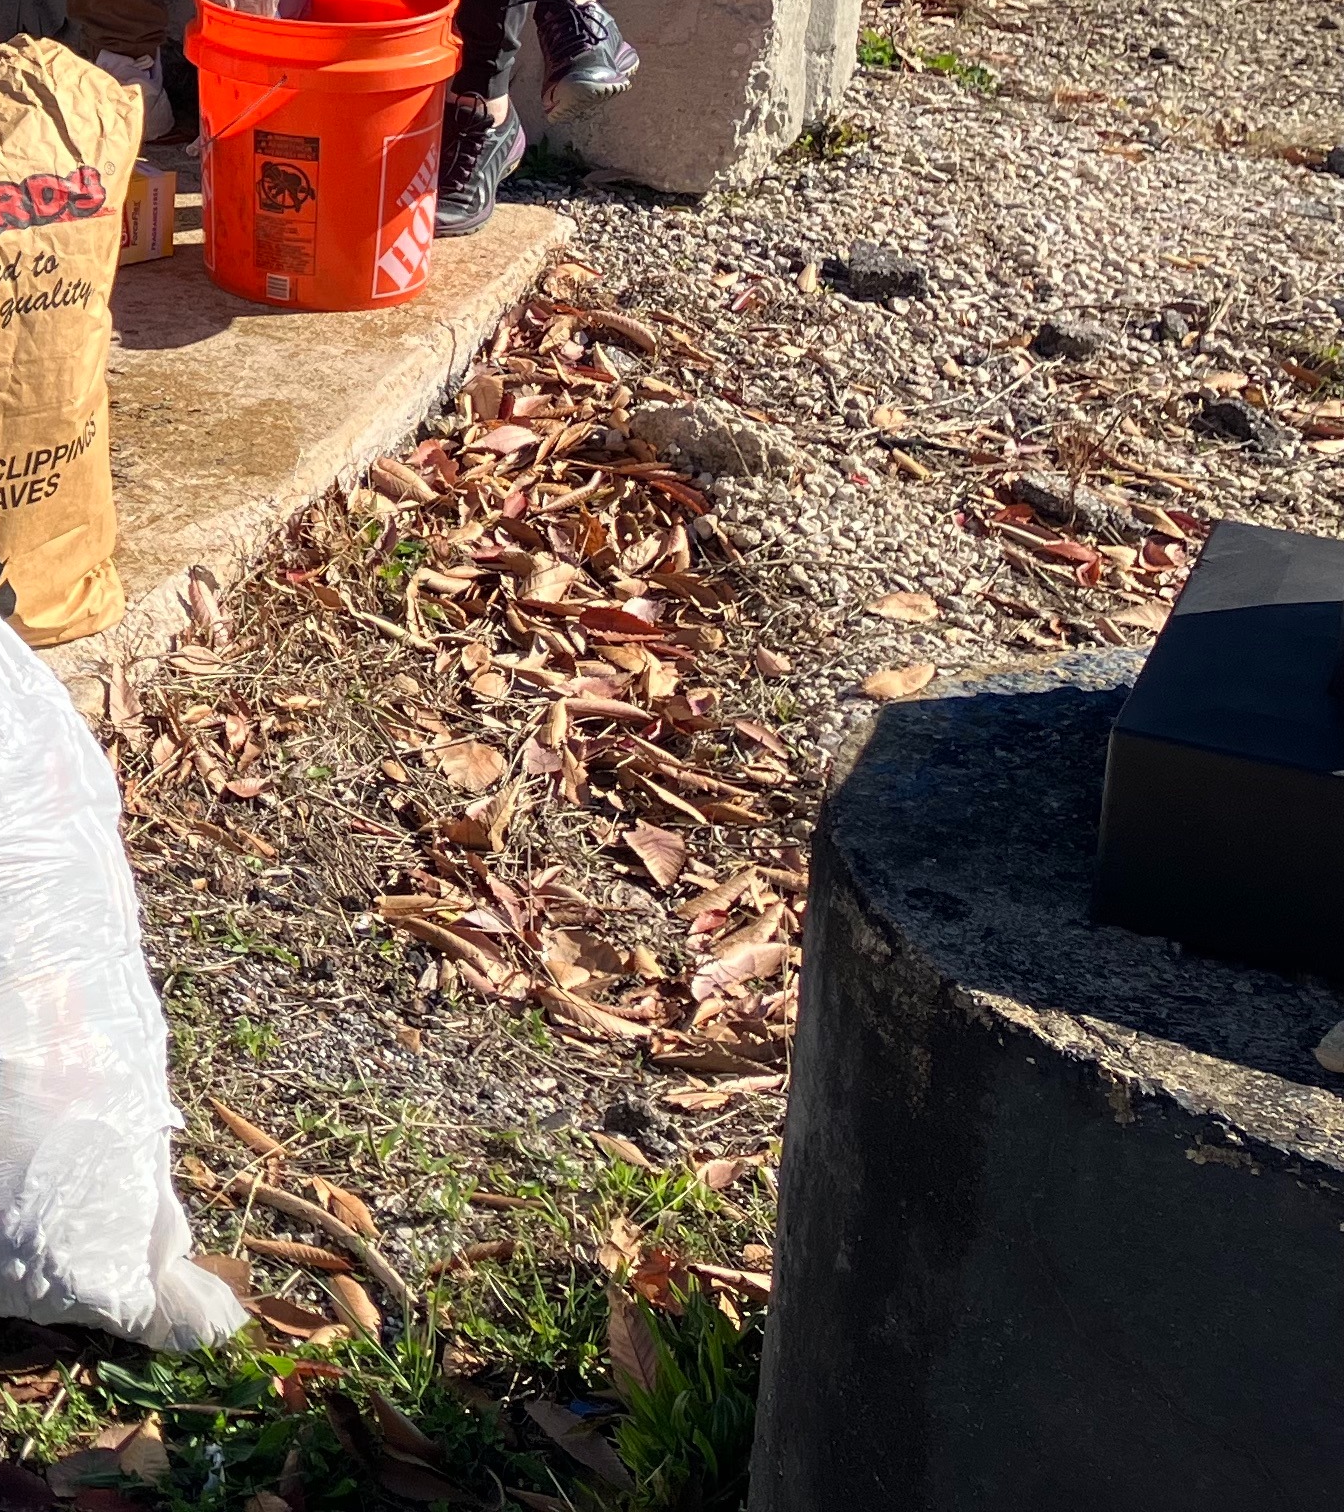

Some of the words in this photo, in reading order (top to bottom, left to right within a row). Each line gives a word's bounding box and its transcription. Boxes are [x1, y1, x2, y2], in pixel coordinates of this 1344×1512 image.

[396, 142, 439, 209] THE
[32, 250, 60, 275] to
[378, 188, 438, 291] HO
[0, 277, 96, 330] quality
